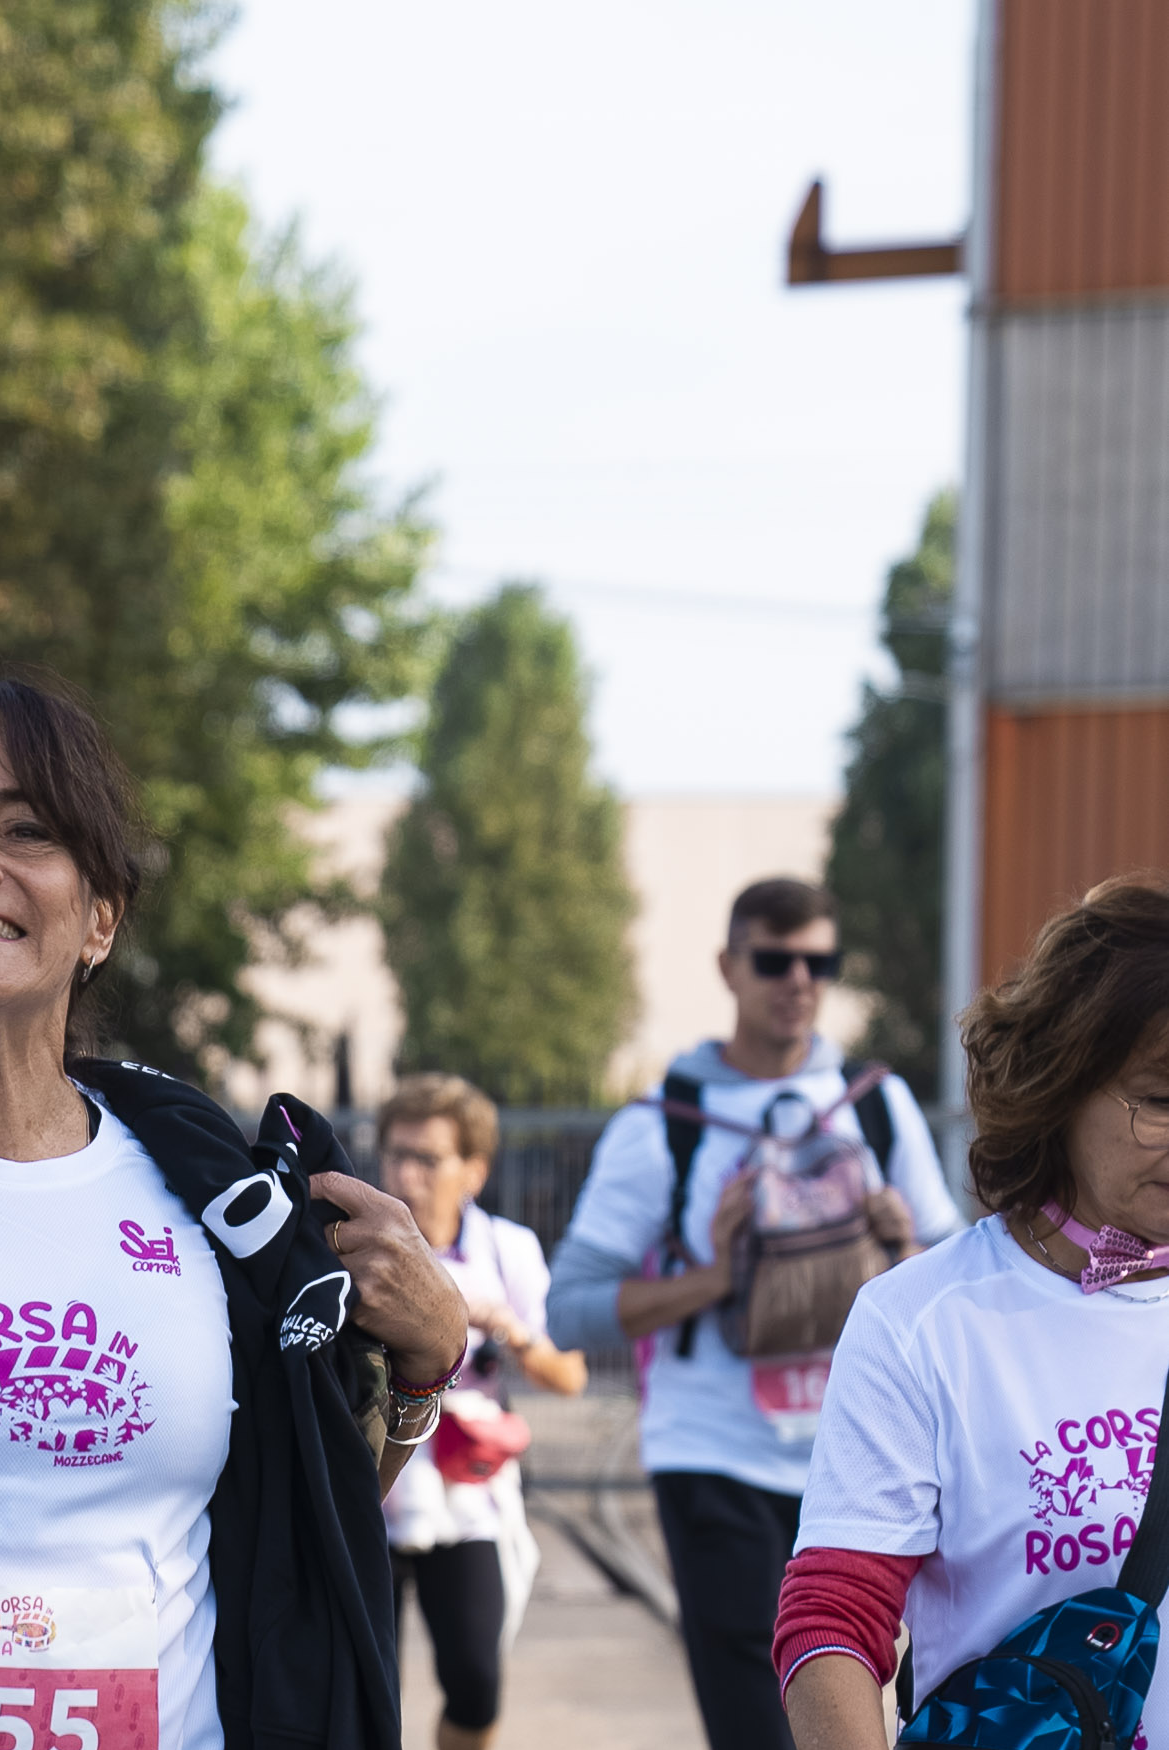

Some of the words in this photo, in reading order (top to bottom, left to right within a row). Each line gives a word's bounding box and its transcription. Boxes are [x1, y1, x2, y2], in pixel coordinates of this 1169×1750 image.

[280, 1314, 335, 1344] MALCES
[109, 1331, 138, 1358] IN
[1019, 1441, 1052, 1465] LA
[1058, 1408, 1160, 1454] CORS
[53, 1451, 123, 1467] MOZZECANE
[1026, 1515, 1138, 1575] ROSA
